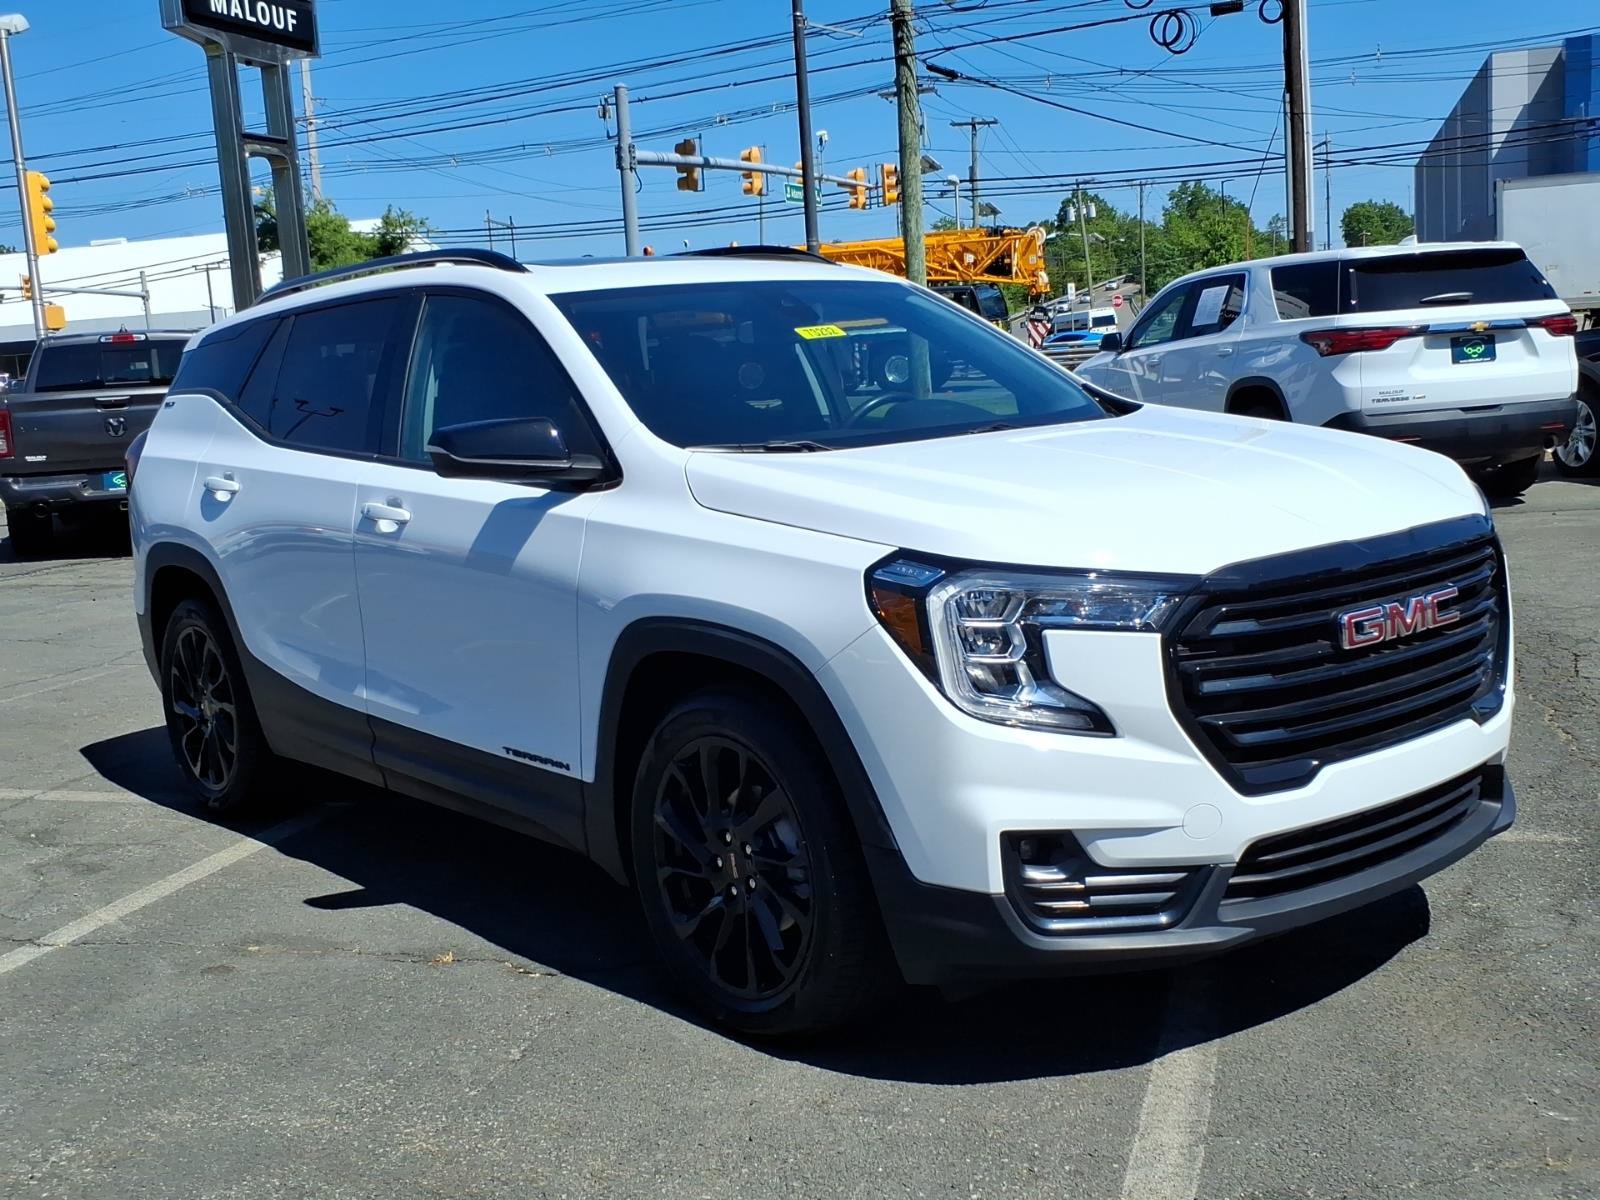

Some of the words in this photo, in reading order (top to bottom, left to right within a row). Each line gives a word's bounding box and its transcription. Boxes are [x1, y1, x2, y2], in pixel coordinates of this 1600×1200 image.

[210, 0, 298, 32] MALOUF
[1342, 586, 1461, 650] GMC
[502, 746, 571, 771] TERRAIN
